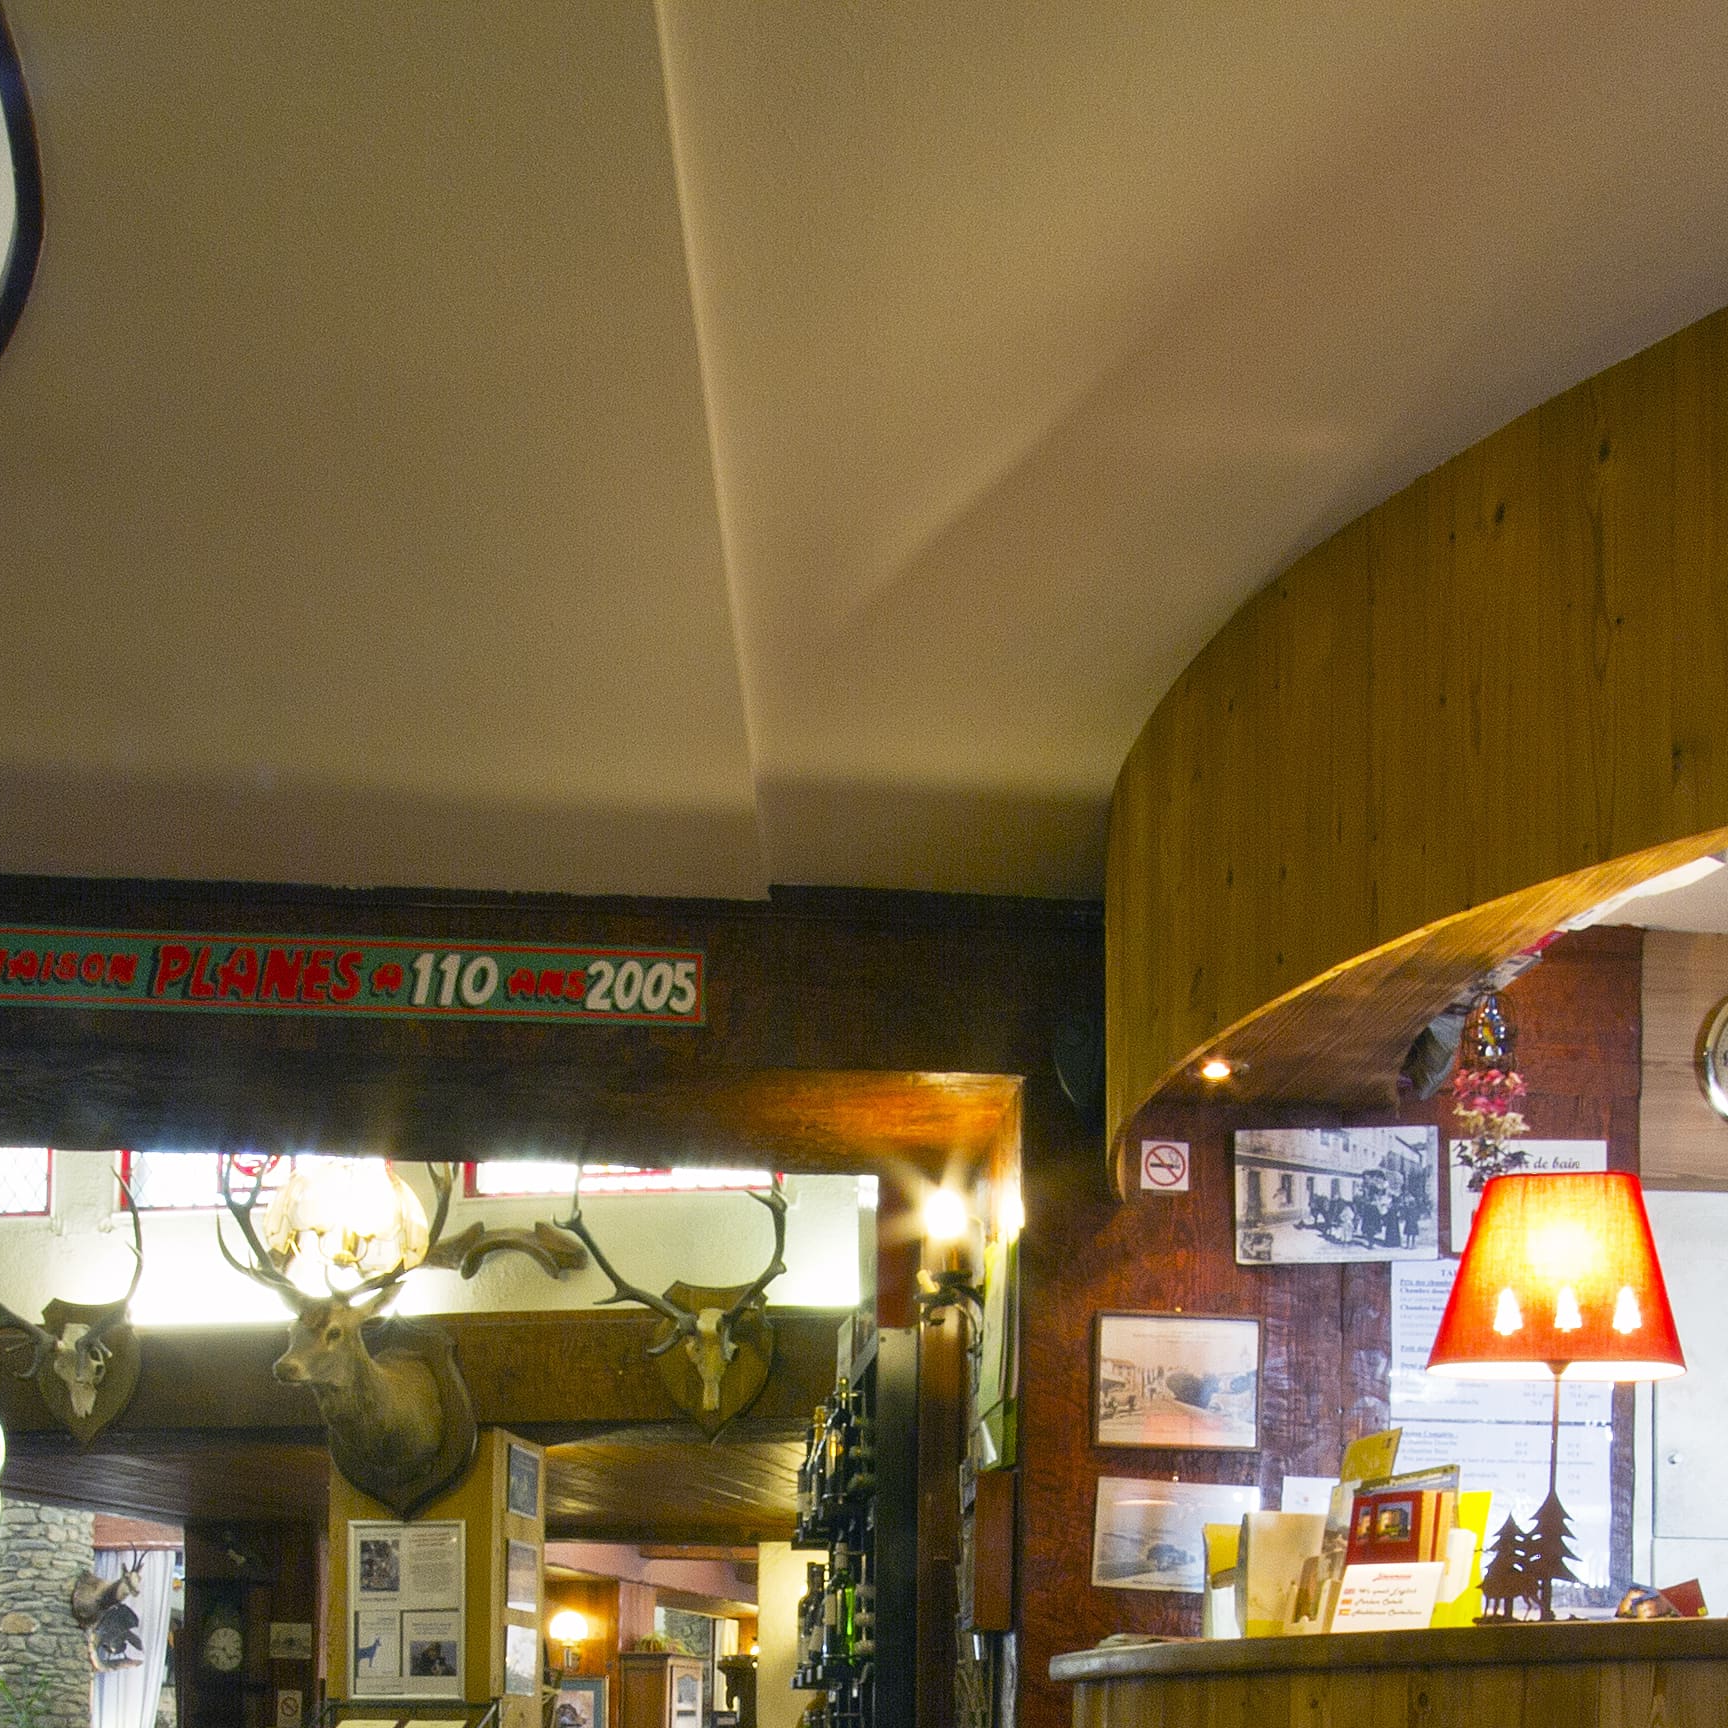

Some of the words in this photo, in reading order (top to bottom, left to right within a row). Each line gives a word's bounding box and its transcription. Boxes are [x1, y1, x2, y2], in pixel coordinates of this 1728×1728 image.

[152, 943, 364, 1003] PLANES
[371, 961, 404, 996] A
[410, 952, 499, 1007] 110
[507, 967, 585, 1001] ANS
[584, 959, 698, 1014] 2005
[1533, 1155, 1549, 1170] de
[1551, 1155, 1581, 1170] bain
